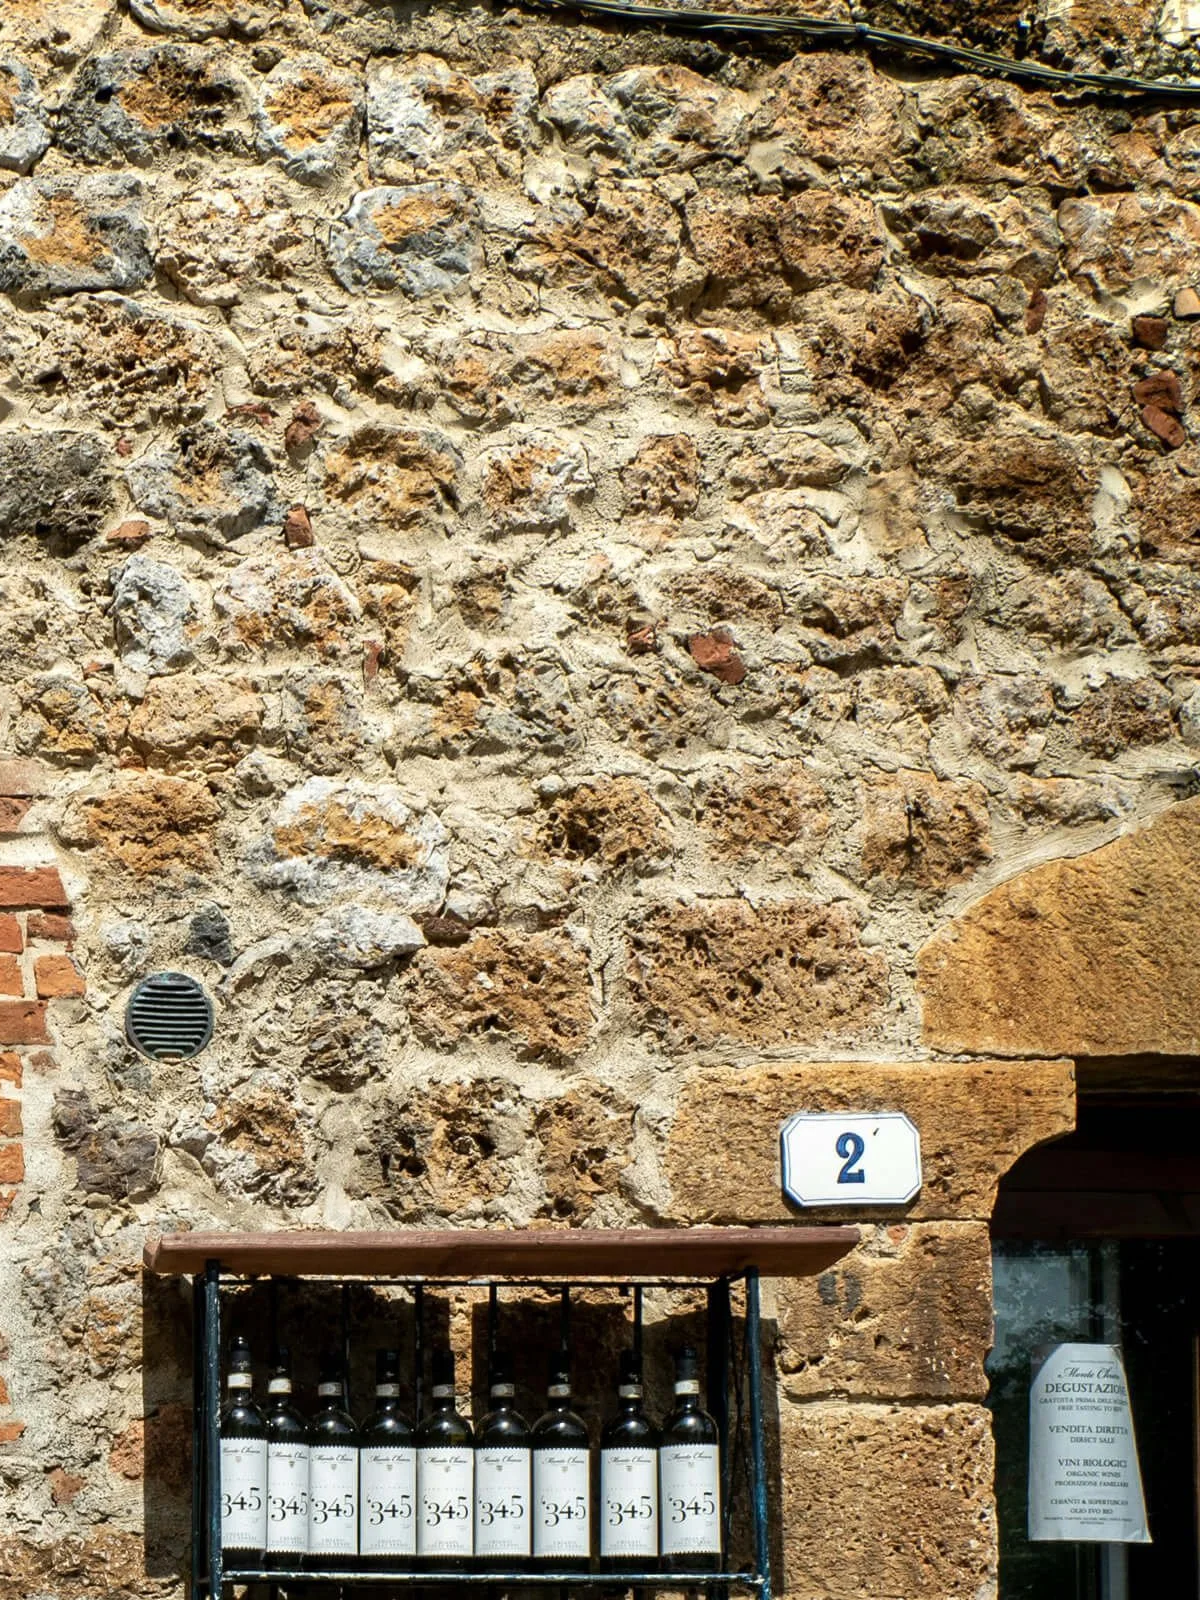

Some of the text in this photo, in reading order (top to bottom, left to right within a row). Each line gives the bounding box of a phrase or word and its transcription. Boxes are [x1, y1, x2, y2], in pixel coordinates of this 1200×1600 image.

[836, 1132, 865, 1184] 2
[1096, 1426, 1128, 1434] DIRETTA
[1083, 1460, 1128, 1468] BIOLOGICI
